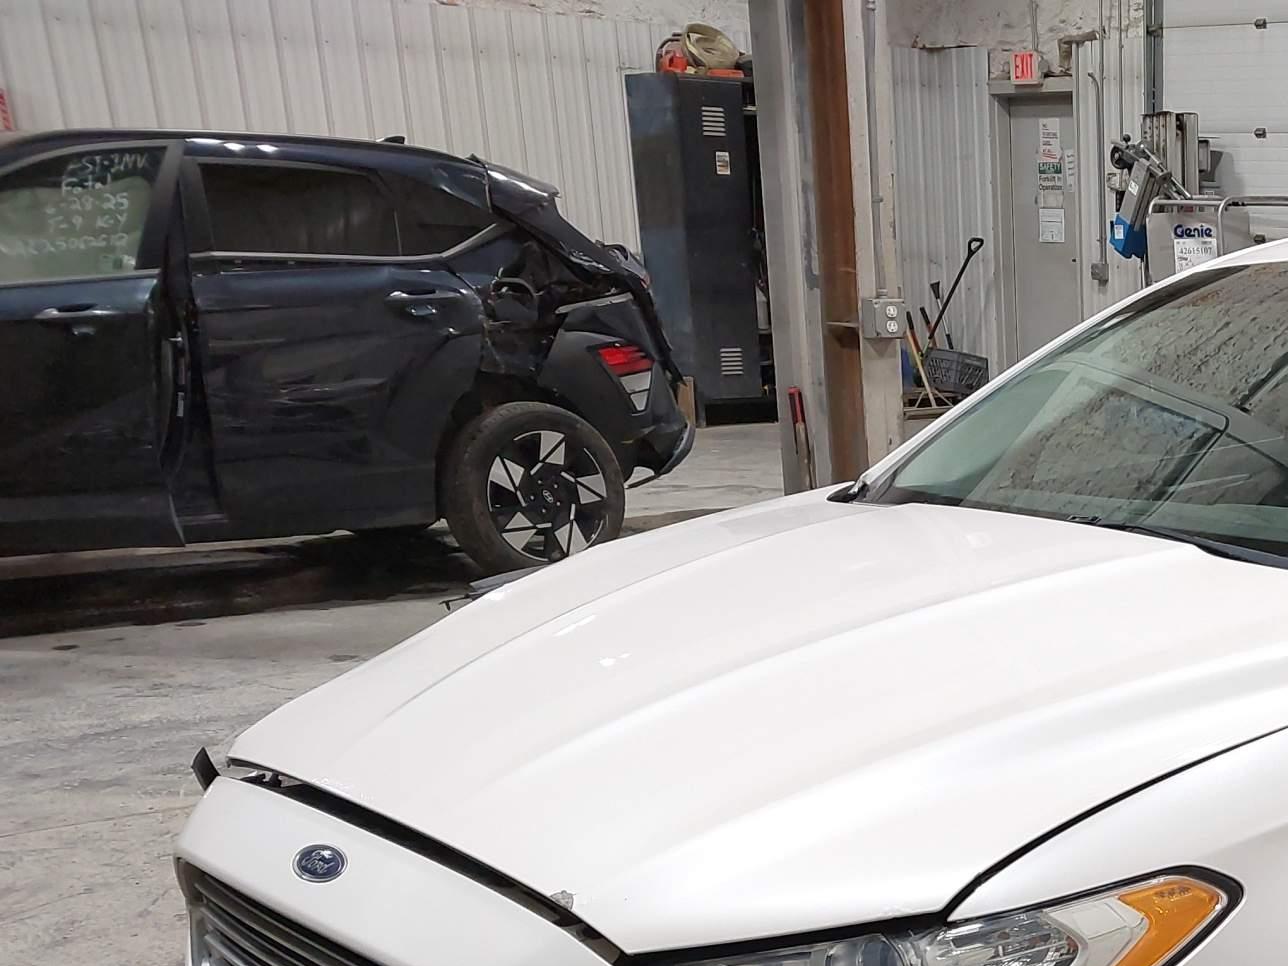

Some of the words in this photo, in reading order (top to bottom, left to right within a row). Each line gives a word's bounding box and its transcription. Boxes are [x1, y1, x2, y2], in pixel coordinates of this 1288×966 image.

[1014, 53, 1034, 79] EXIT
[1174, 224, 1212, 238] Genie
[301, 849, 335, 873] Ford
